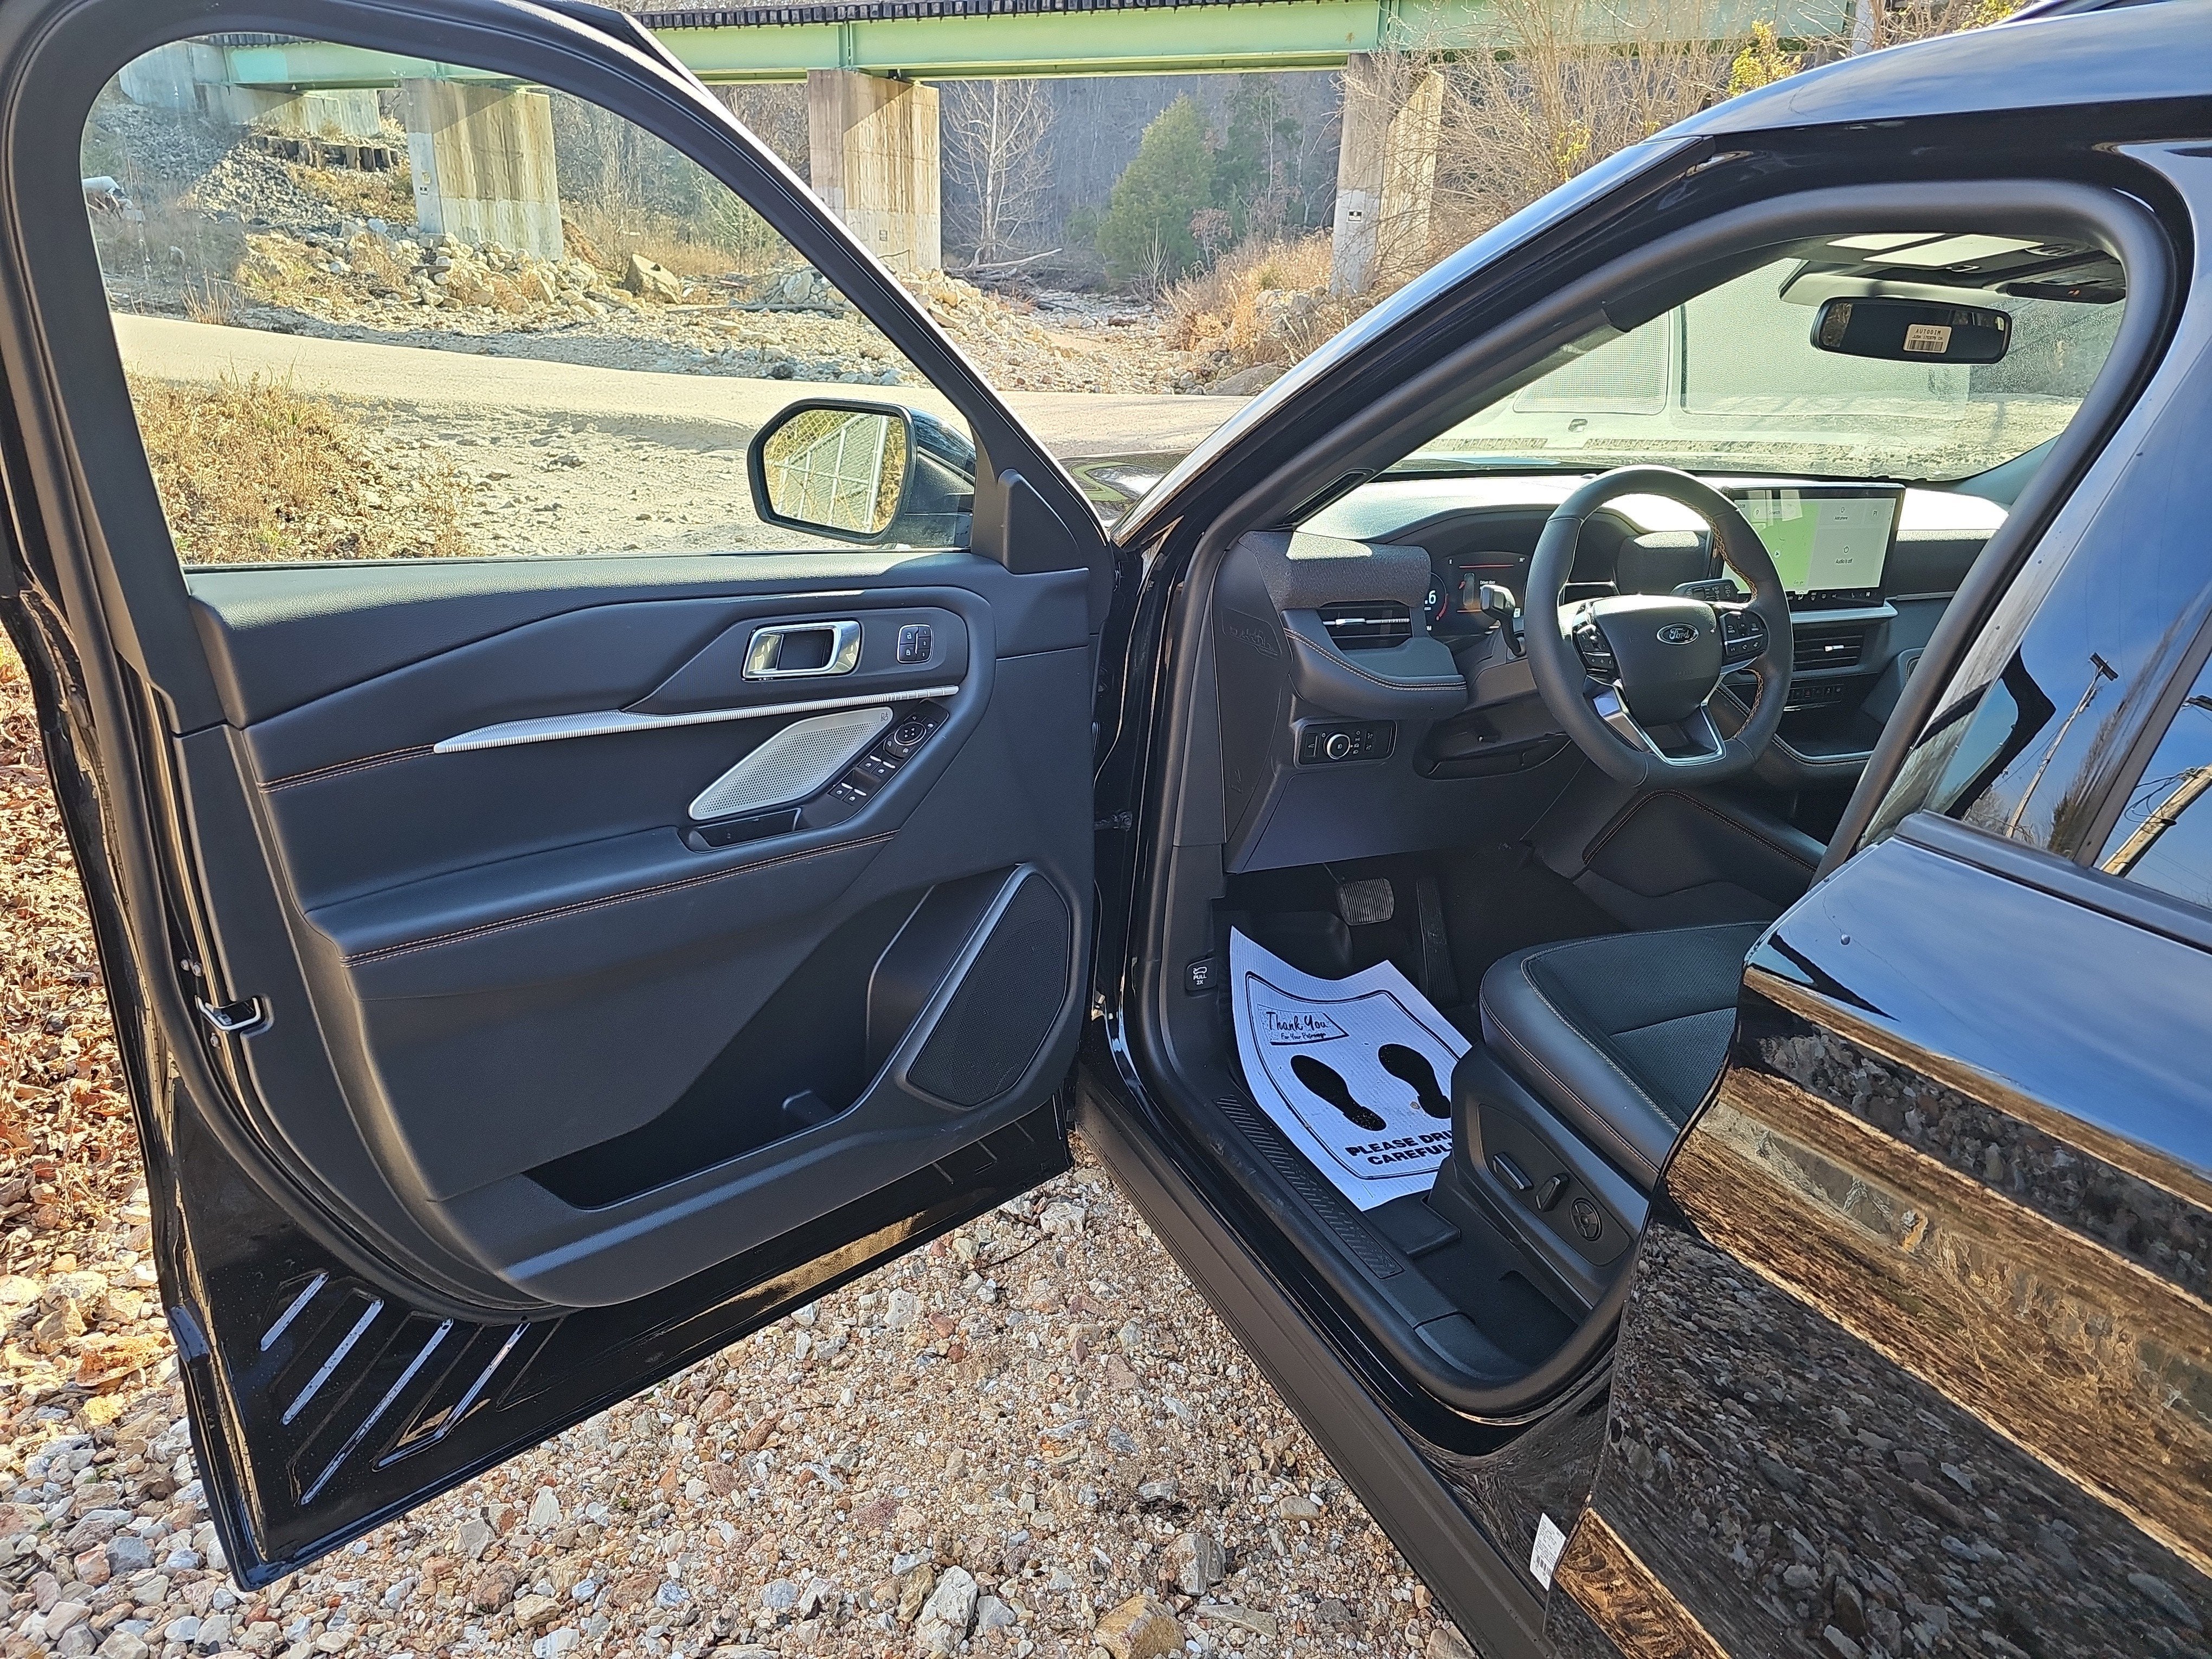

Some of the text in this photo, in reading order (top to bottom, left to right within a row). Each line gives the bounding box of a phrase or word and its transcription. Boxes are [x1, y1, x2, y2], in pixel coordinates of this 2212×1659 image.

[1669, 628, 1690, 640] Ford
[1265, 1011, 1329, 1031] Thank You
[1345, 1137, 1419, 1156] PLEASE
